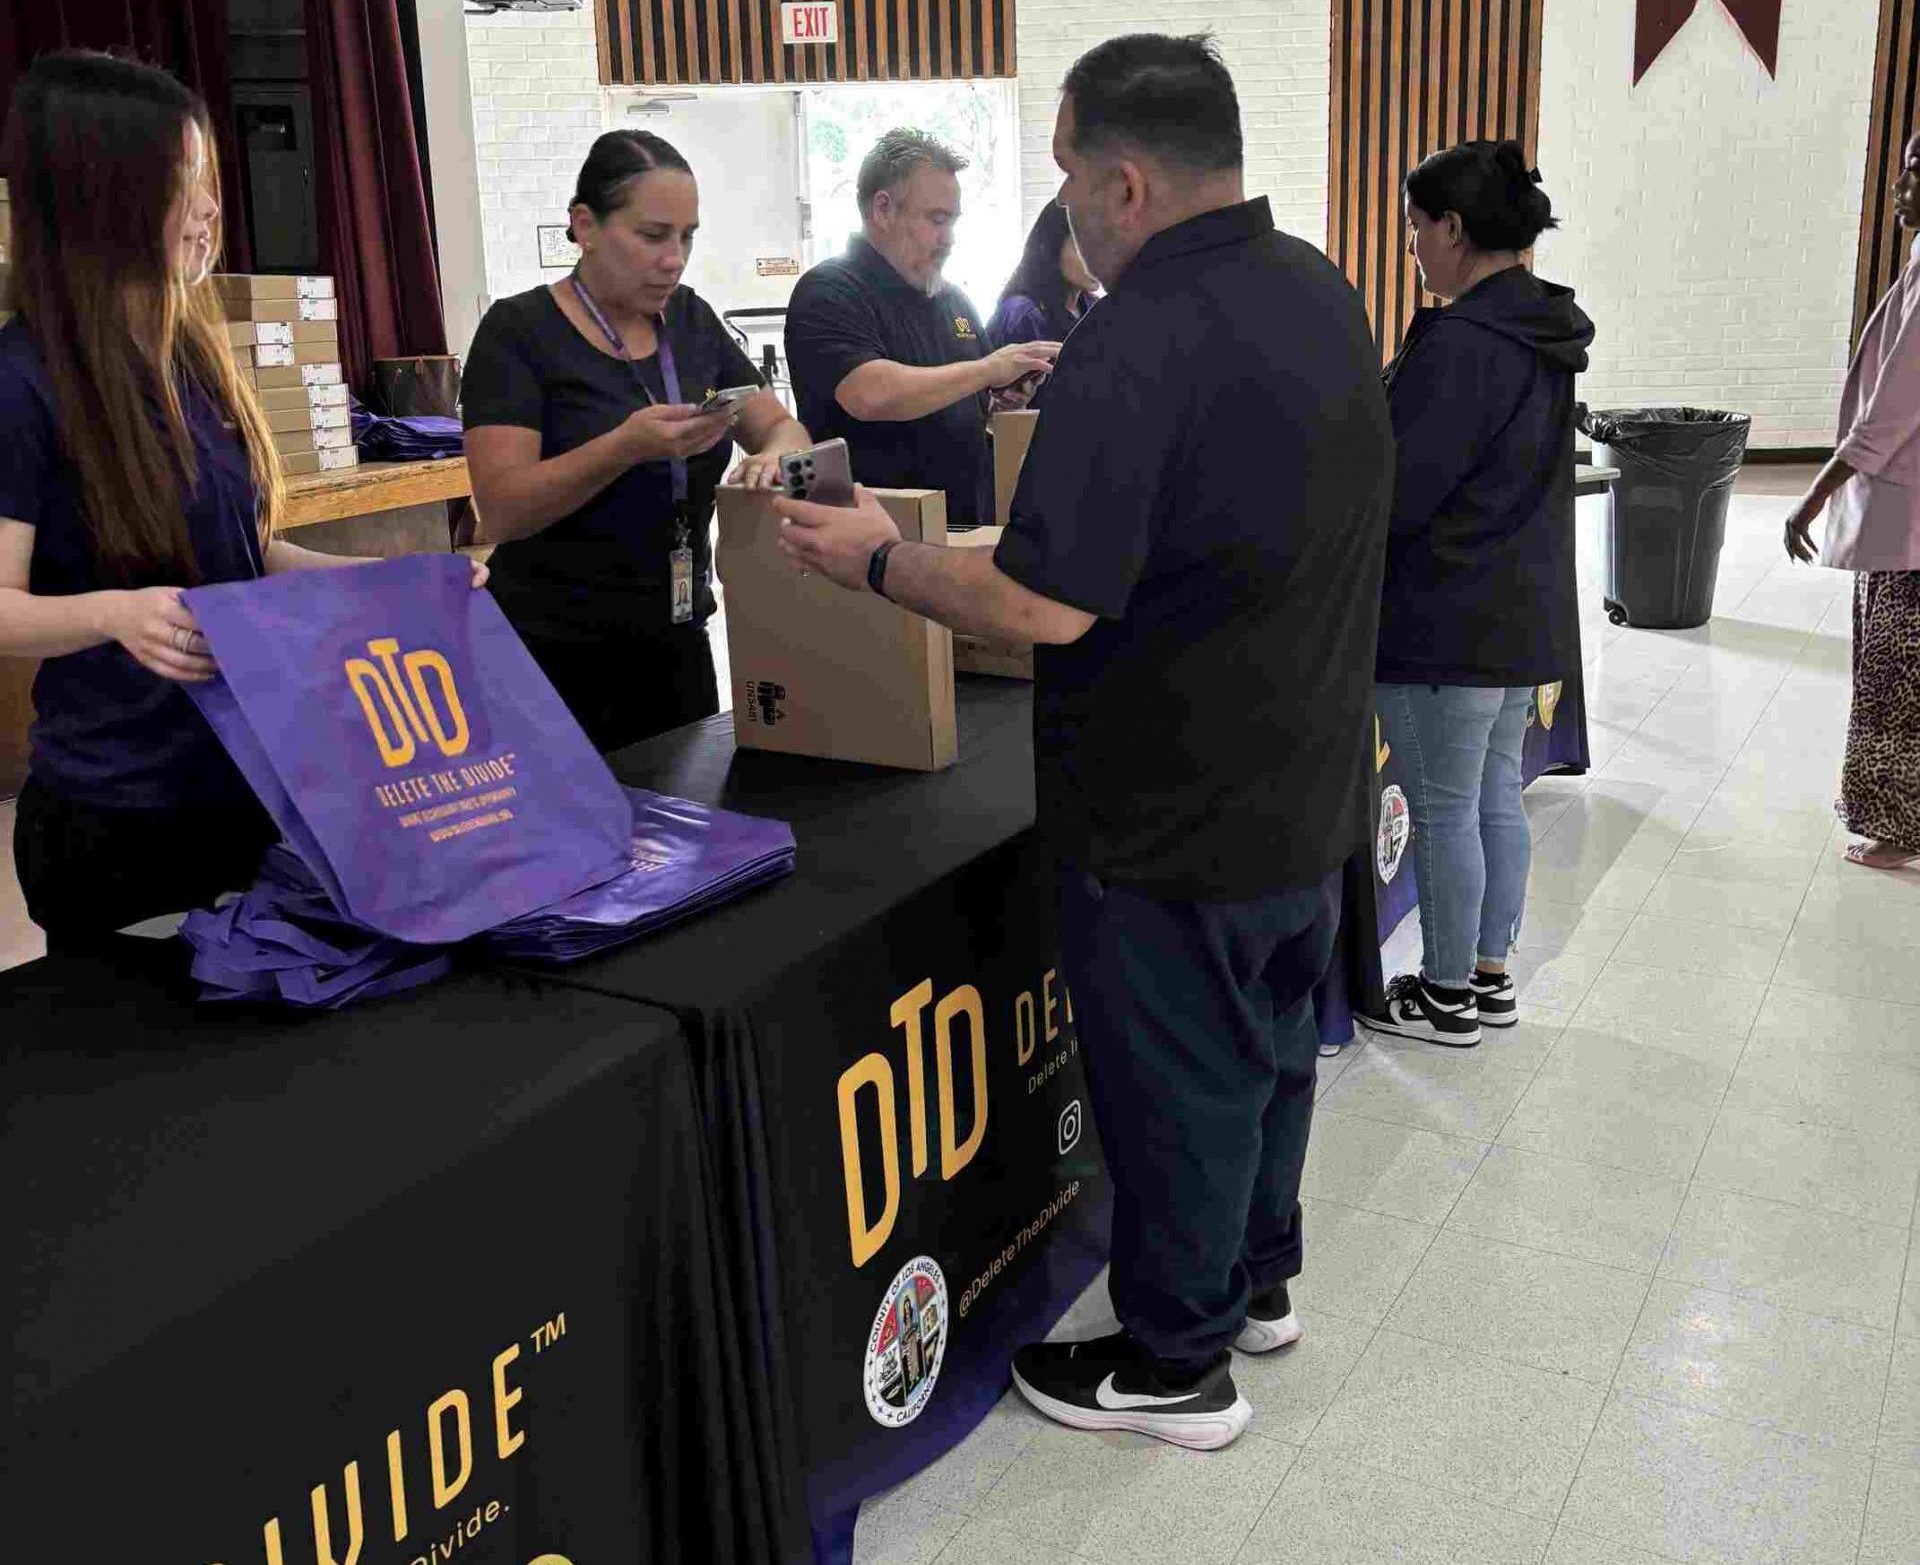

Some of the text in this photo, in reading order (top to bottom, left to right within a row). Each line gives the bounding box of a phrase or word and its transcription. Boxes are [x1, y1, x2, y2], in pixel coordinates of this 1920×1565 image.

[792, 7, 829, 37] EXIT
[345, 637, 470, 767] DTD
[375, 776, 432, 807] DELETE
[431, 771, 462, 794] THE
[1028, 1050, 1067, 1095] Delete
[837, 977, 988, 1268] DTD
[959, 1180, 1080, 1318] @DeleteTheDivide
[869, 1260, 942, 1353] COUNTY OF LOS ANGELES
[896, 1374, 936, 1423] CALIFORNIA
